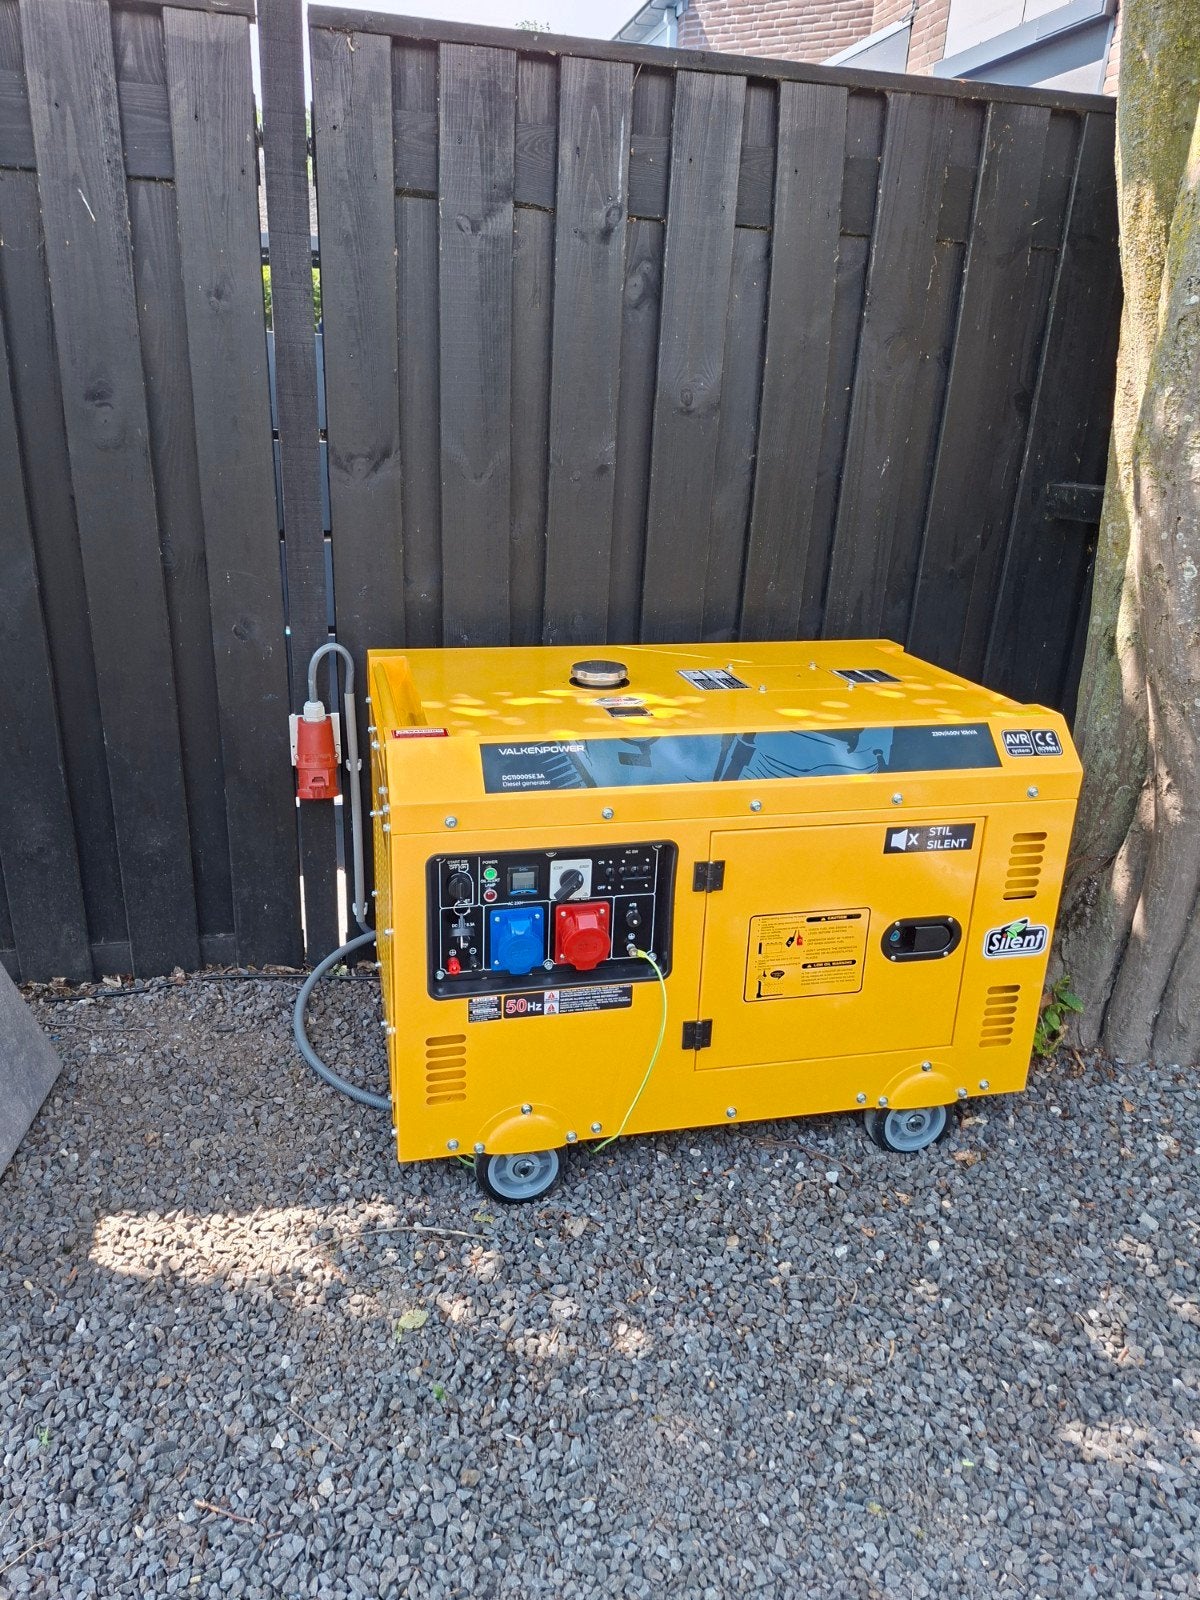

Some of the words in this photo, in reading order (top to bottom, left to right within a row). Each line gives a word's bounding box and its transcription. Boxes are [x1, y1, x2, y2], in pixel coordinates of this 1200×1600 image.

[1006, 733, 1030, 744] AVR
[1035, 732, 1056, 746] CE
[499, 744, 585, 755] VALKENPOWER
[522, 780, 551, 788] generator
[928, 826, 953, 837] STIL
[926, 838, 968, 850] SILENT
[989, 930, 1043, 951] Silent
[506, 998, 542, 1014] 50Hz
